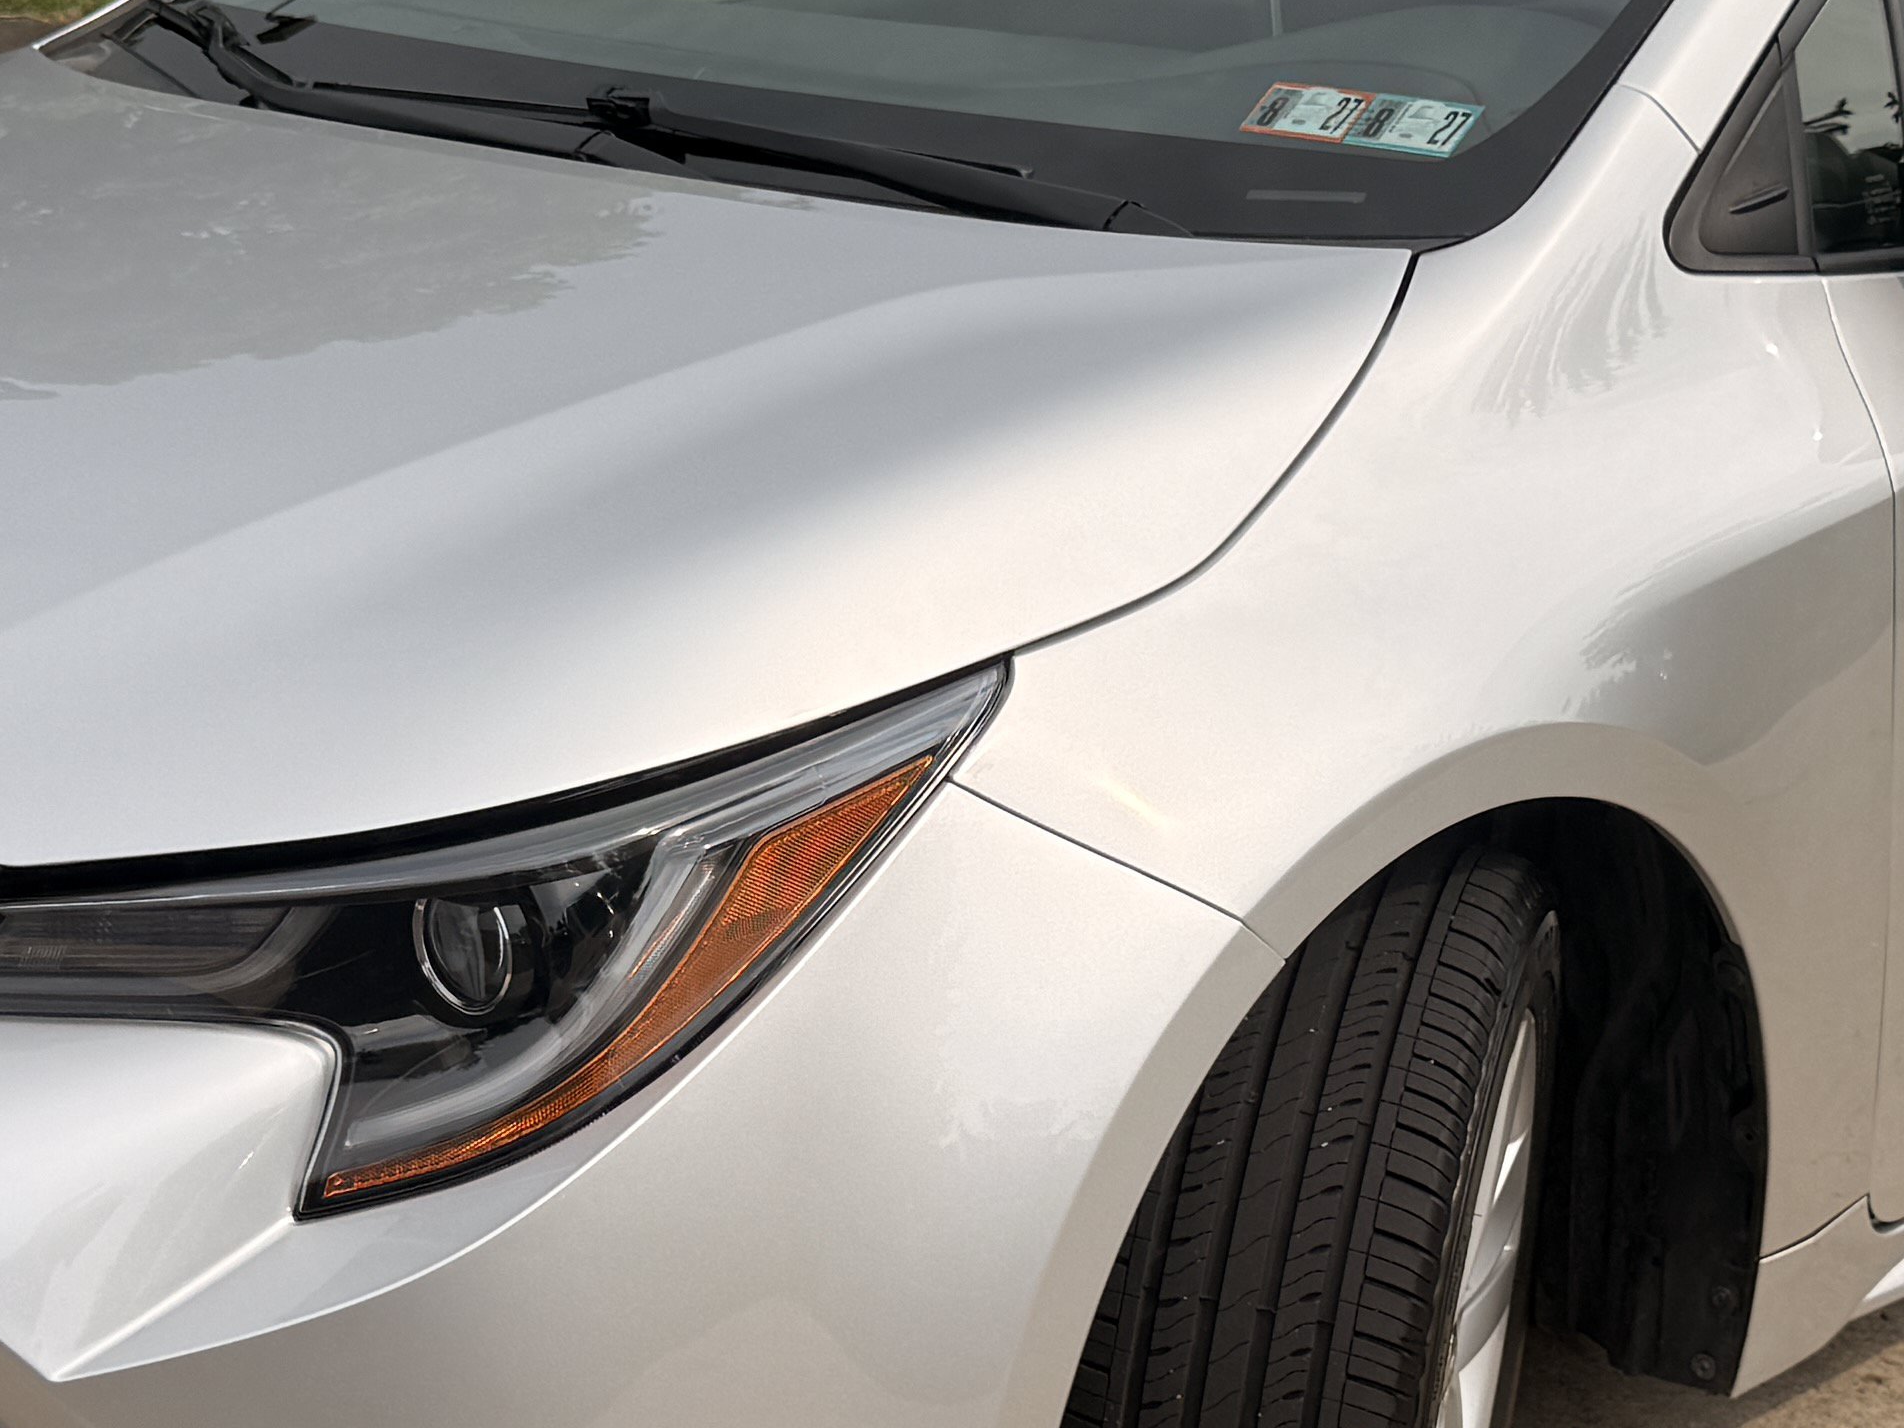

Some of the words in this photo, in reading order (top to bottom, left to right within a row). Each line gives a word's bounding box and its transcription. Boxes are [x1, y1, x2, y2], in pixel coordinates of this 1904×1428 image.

[1258, 98, 1289, 127] 8
[1319, 97, 1363, 134] 27
[1363, 108, 1395, 139] 8
[1426, 111, 1472, 148] 27
